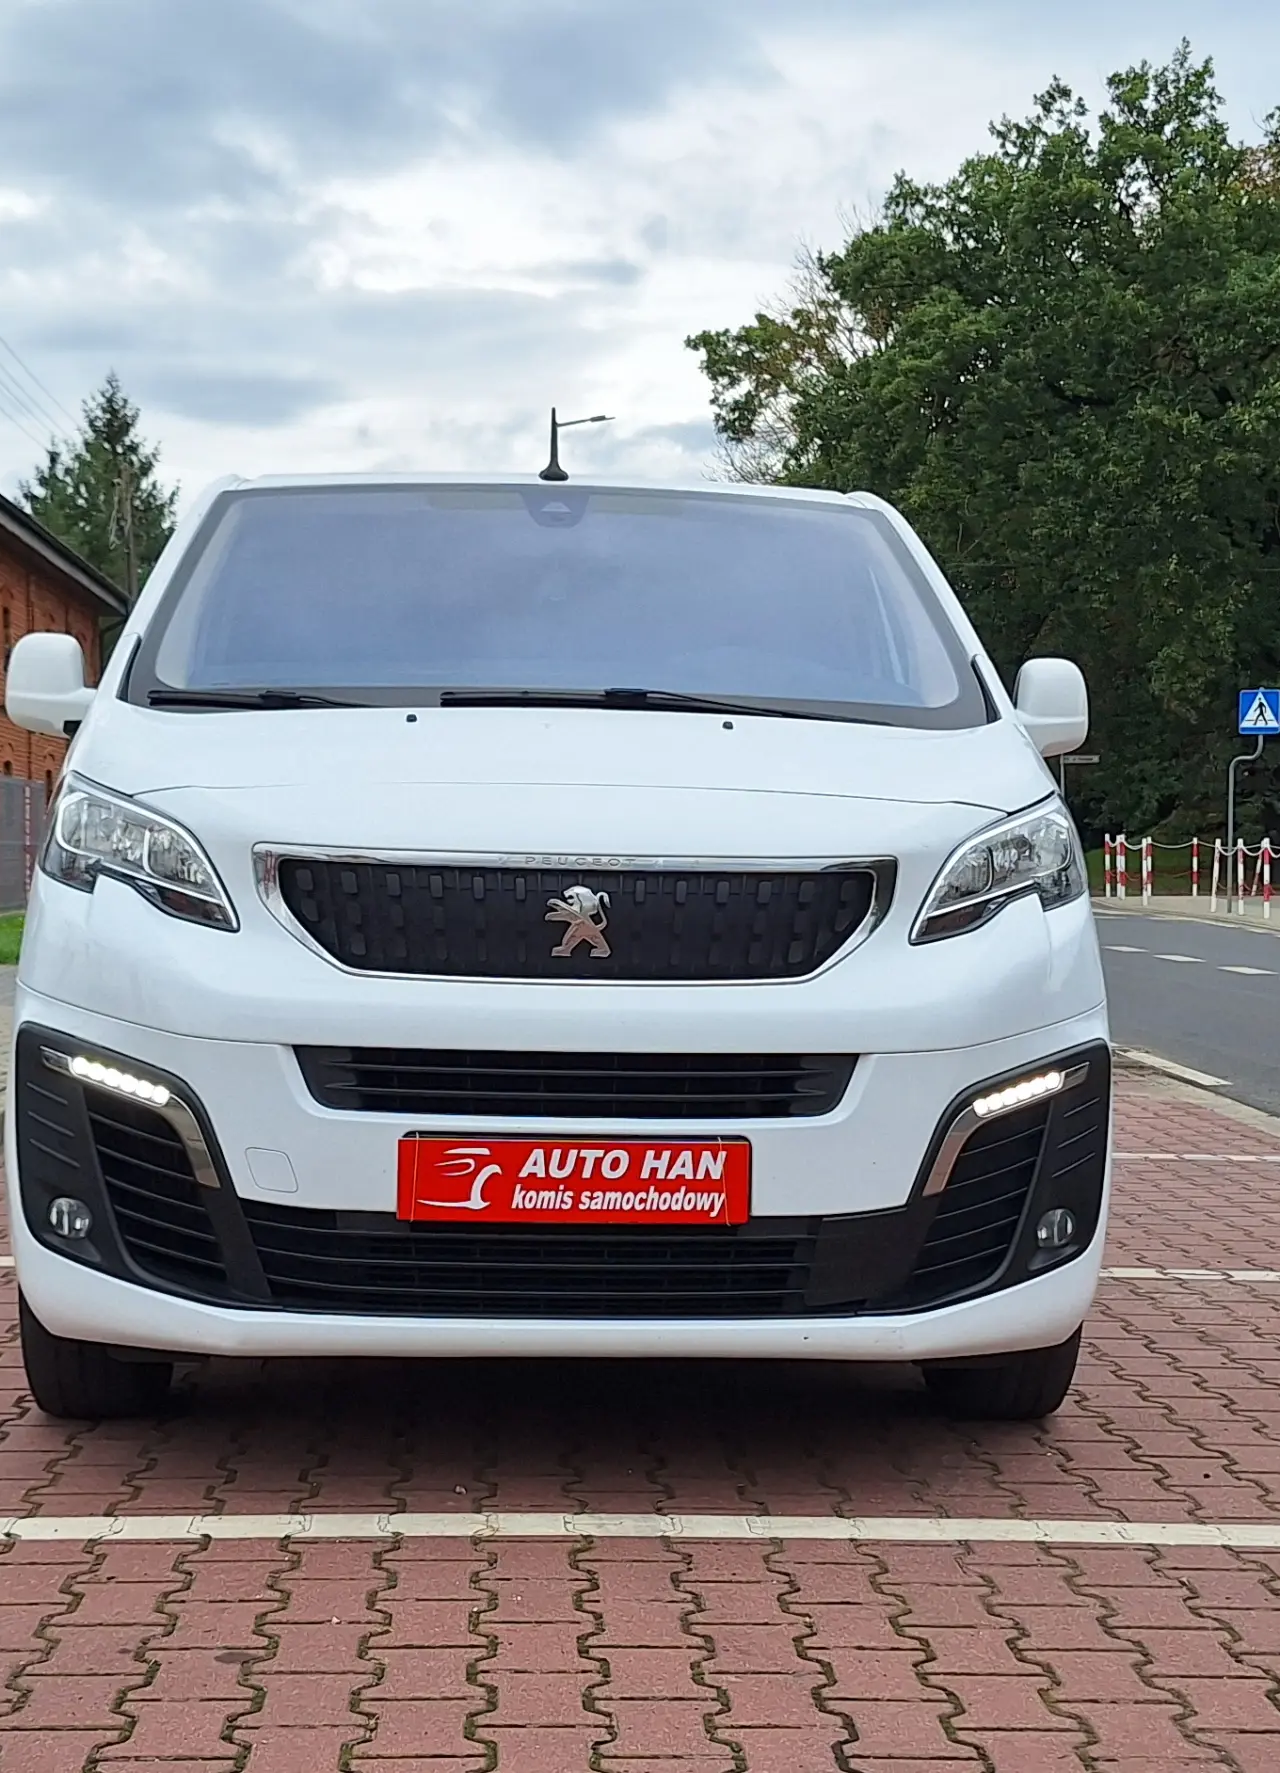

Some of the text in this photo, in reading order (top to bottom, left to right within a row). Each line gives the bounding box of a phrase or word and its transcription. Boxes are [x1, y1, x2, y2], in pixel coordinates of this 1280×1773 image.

[524, 856, 636, 867] PEUGEOT
[518, 1148, 728, 1180] AUTO HAN
[511, 1184, 725, 1218] komis samochodowy
